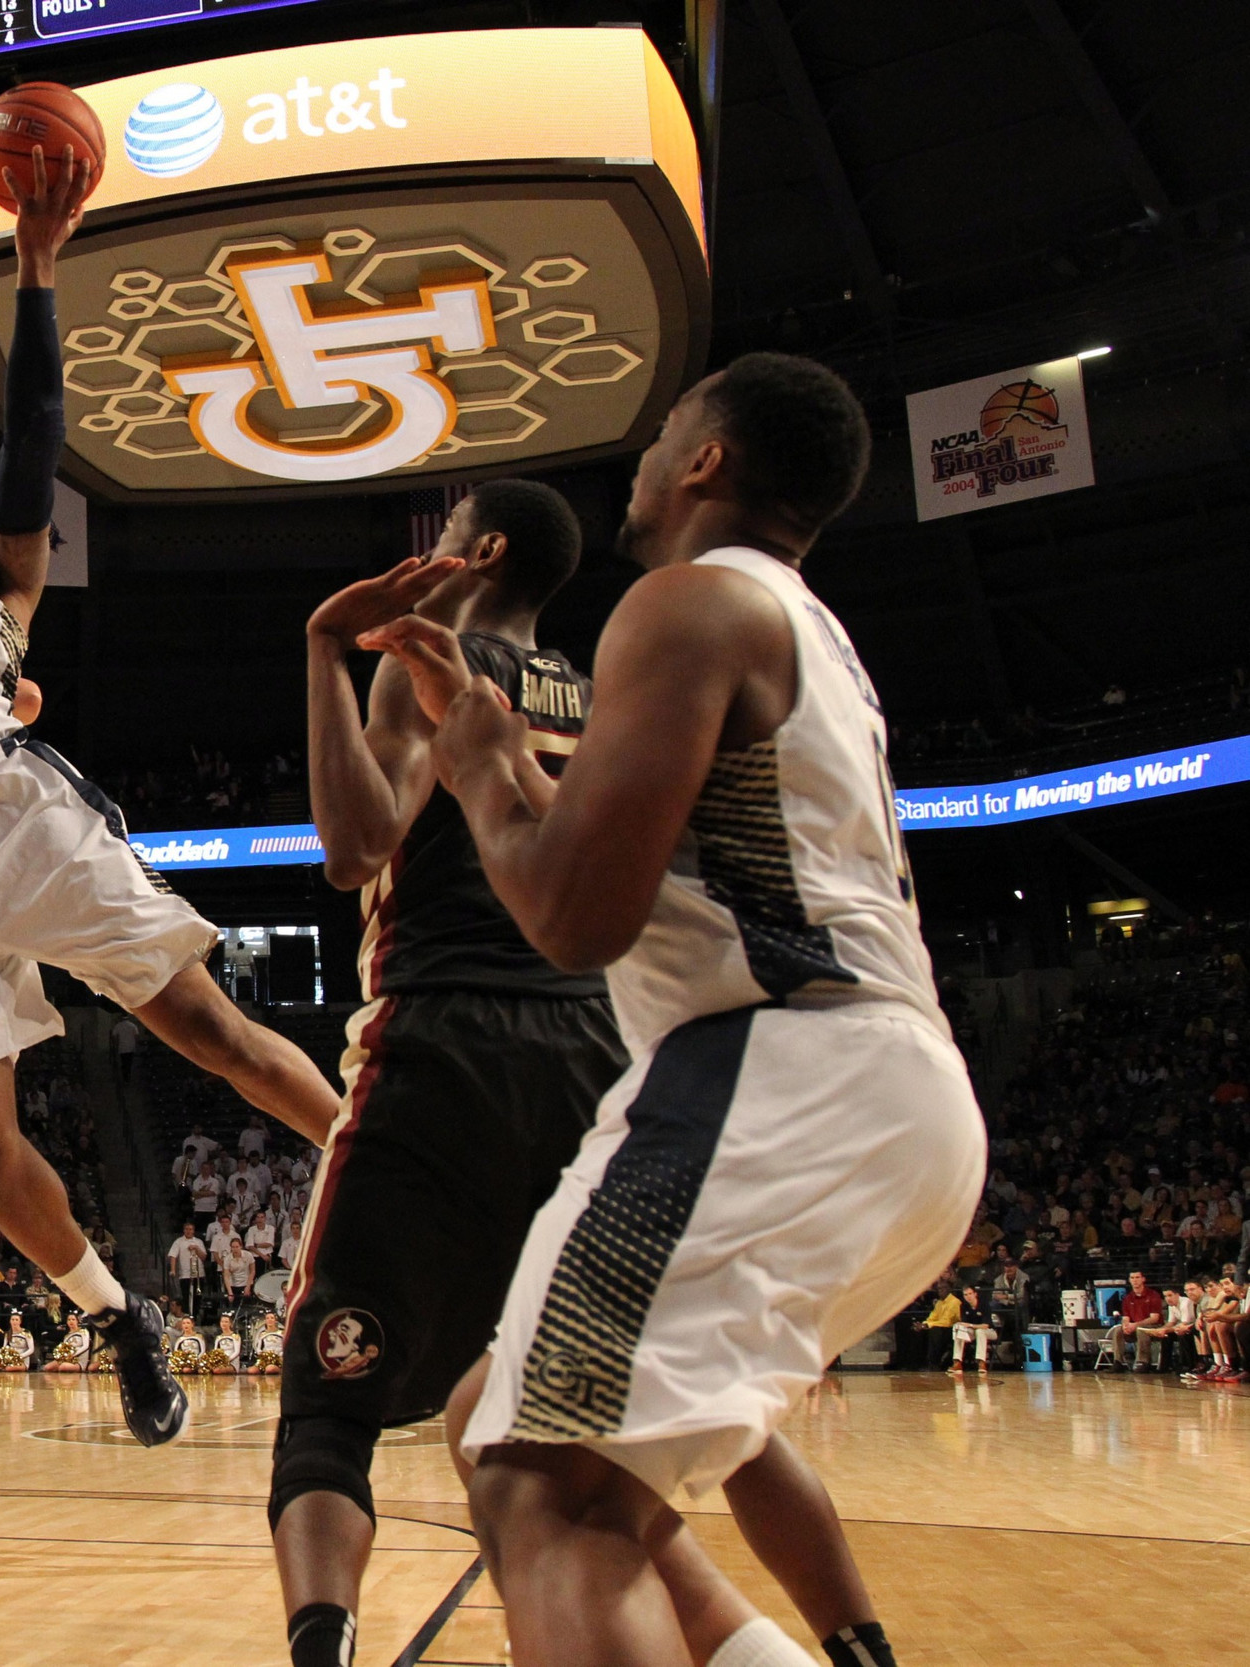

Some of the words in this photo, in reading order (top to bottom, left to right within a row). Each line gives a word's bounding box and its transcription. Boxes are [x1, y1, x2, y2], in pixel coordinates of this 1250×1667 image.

[3, 13, 14, 28] 9
[4, 30, 15, 45] 4
[241, 67, 408, 145] at&t
[930, 430, 979, 453] NCAA
[1018, 434, 1040, 447] San
[1019, 440, 1066, 457] Antonio
[931, 435, 1017, 483] Final
[974, 453, 1055, 498] Four
[942, 479, 975, 496] 2004
[528, 657, 562, 673] ACC
[521, 668, 583, 719] SMITH
[894, 792, 979, 821] Standard
[983, 792, 1010, 814] for
[1014, 779, 1093, 811] Moving
[1096, 772, 1131, 796] the
